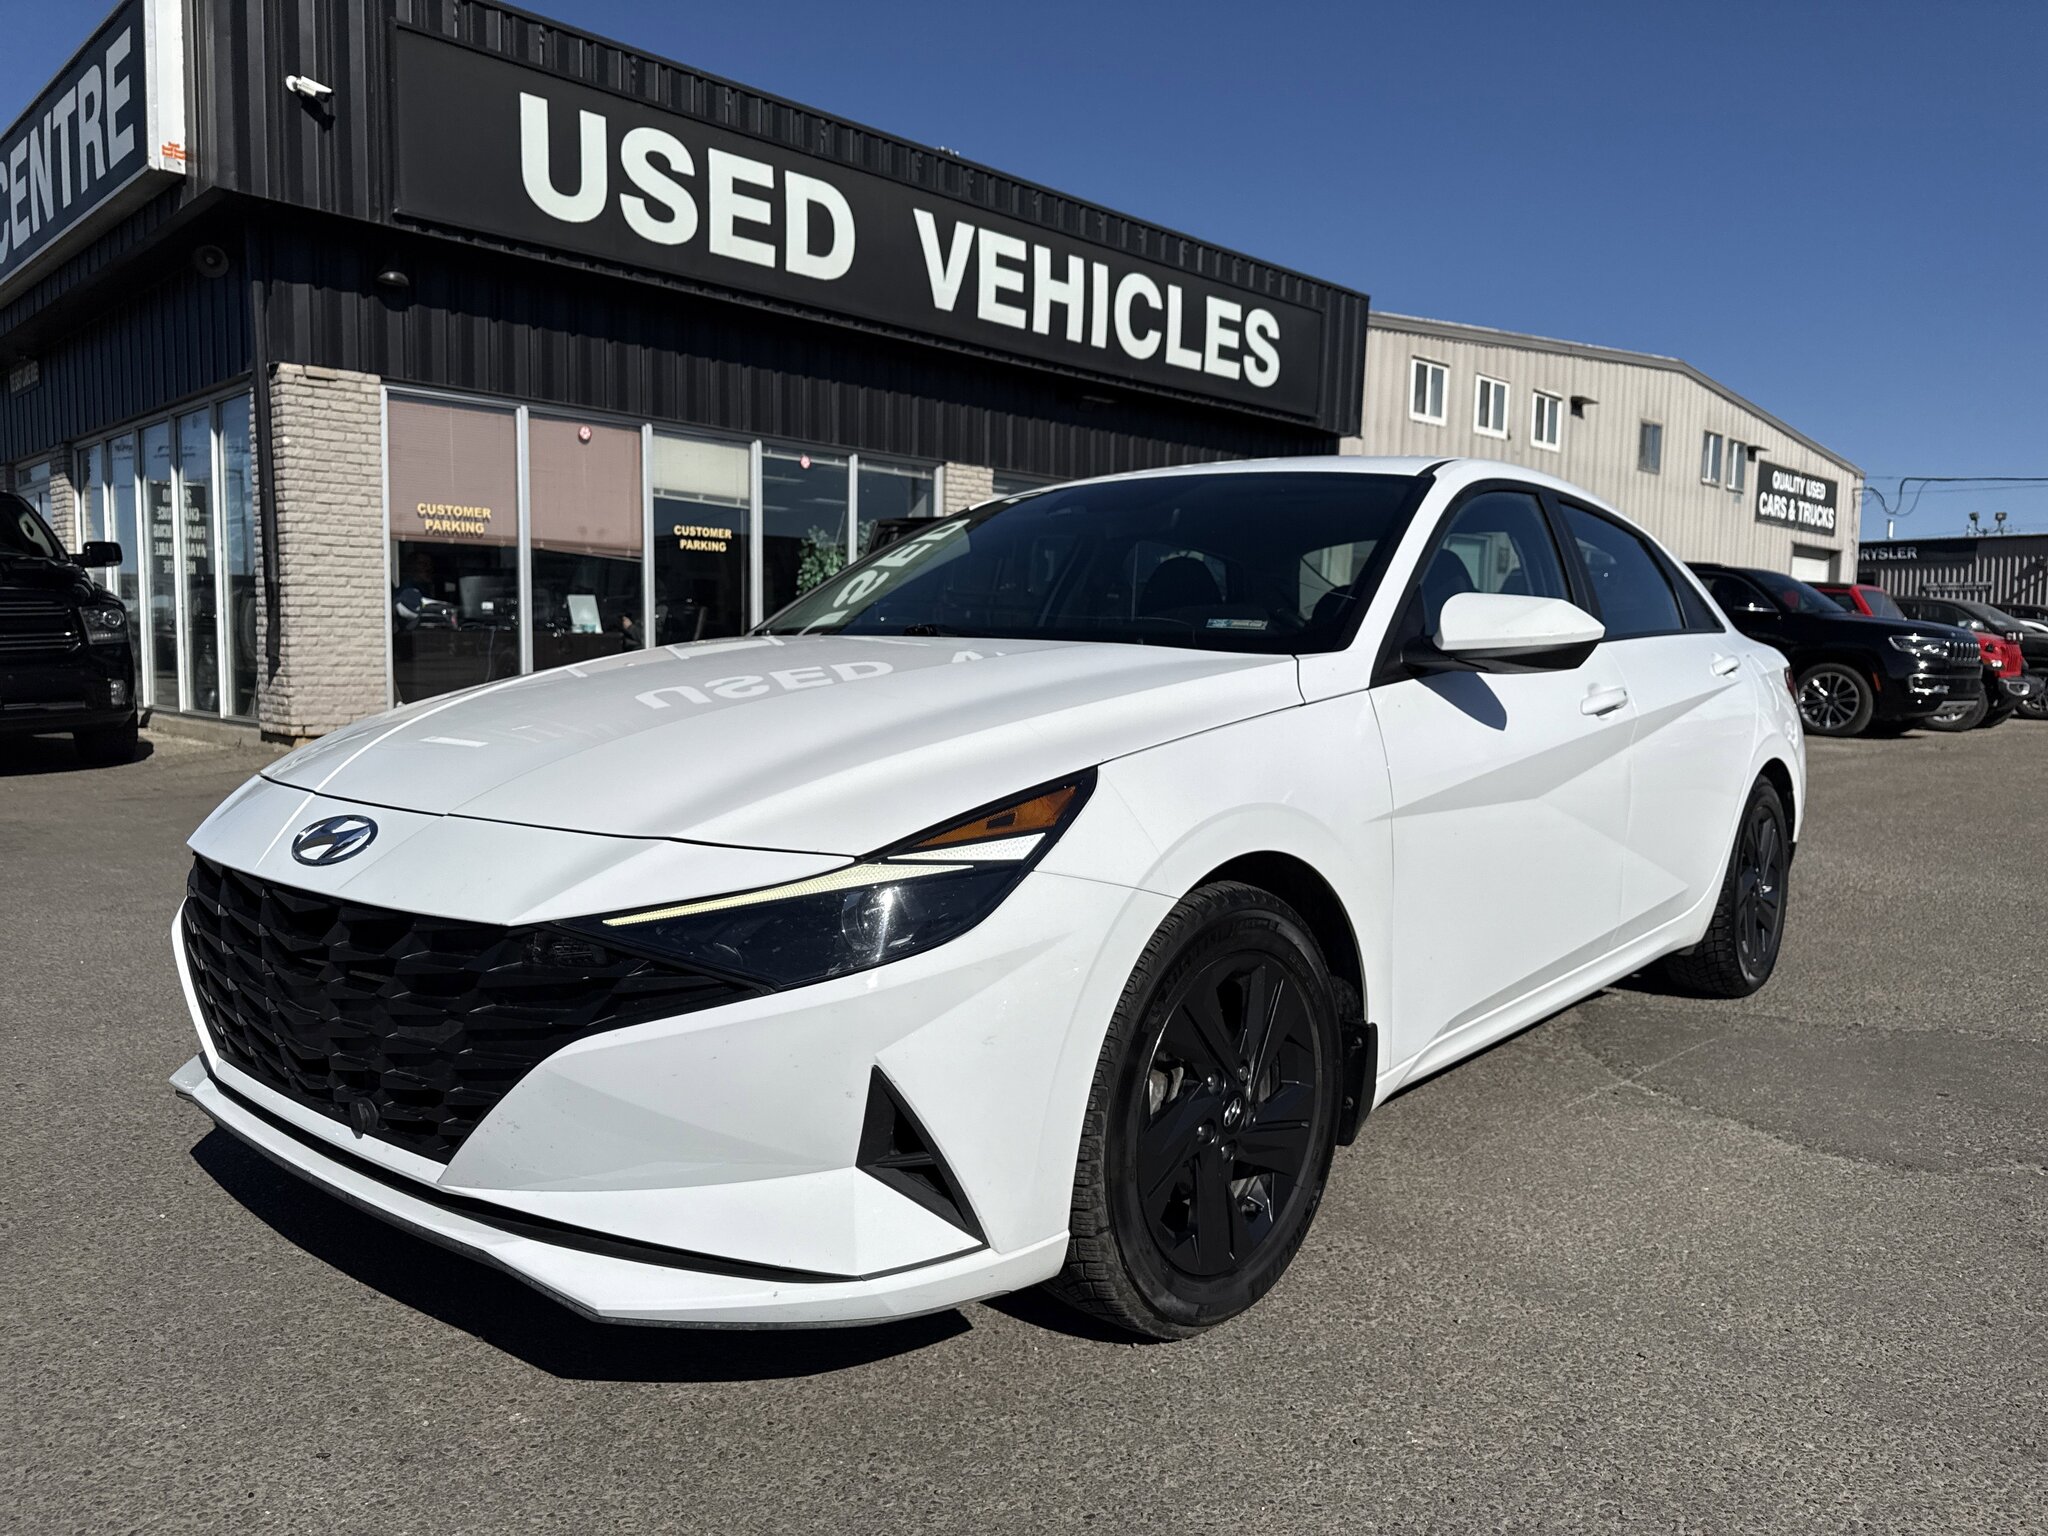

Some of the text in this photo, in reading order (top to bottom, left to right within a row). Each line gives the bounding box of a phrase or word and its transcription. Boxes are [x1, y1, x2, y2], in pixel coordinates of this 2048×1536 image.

[519, 92, 1281, 389] USED VEHICLES
[1771, 470, 1827, 501] QUALITY USED
[417, 503, 492, 519] CUSTOMER
[1758, 491, 1835, 530] CARS & TRUCKS
[425, 519, 485, 534] PARKING
[673, 524, 733, 540] CUSTOMER
[679, 539, 727, 552] PARKING
